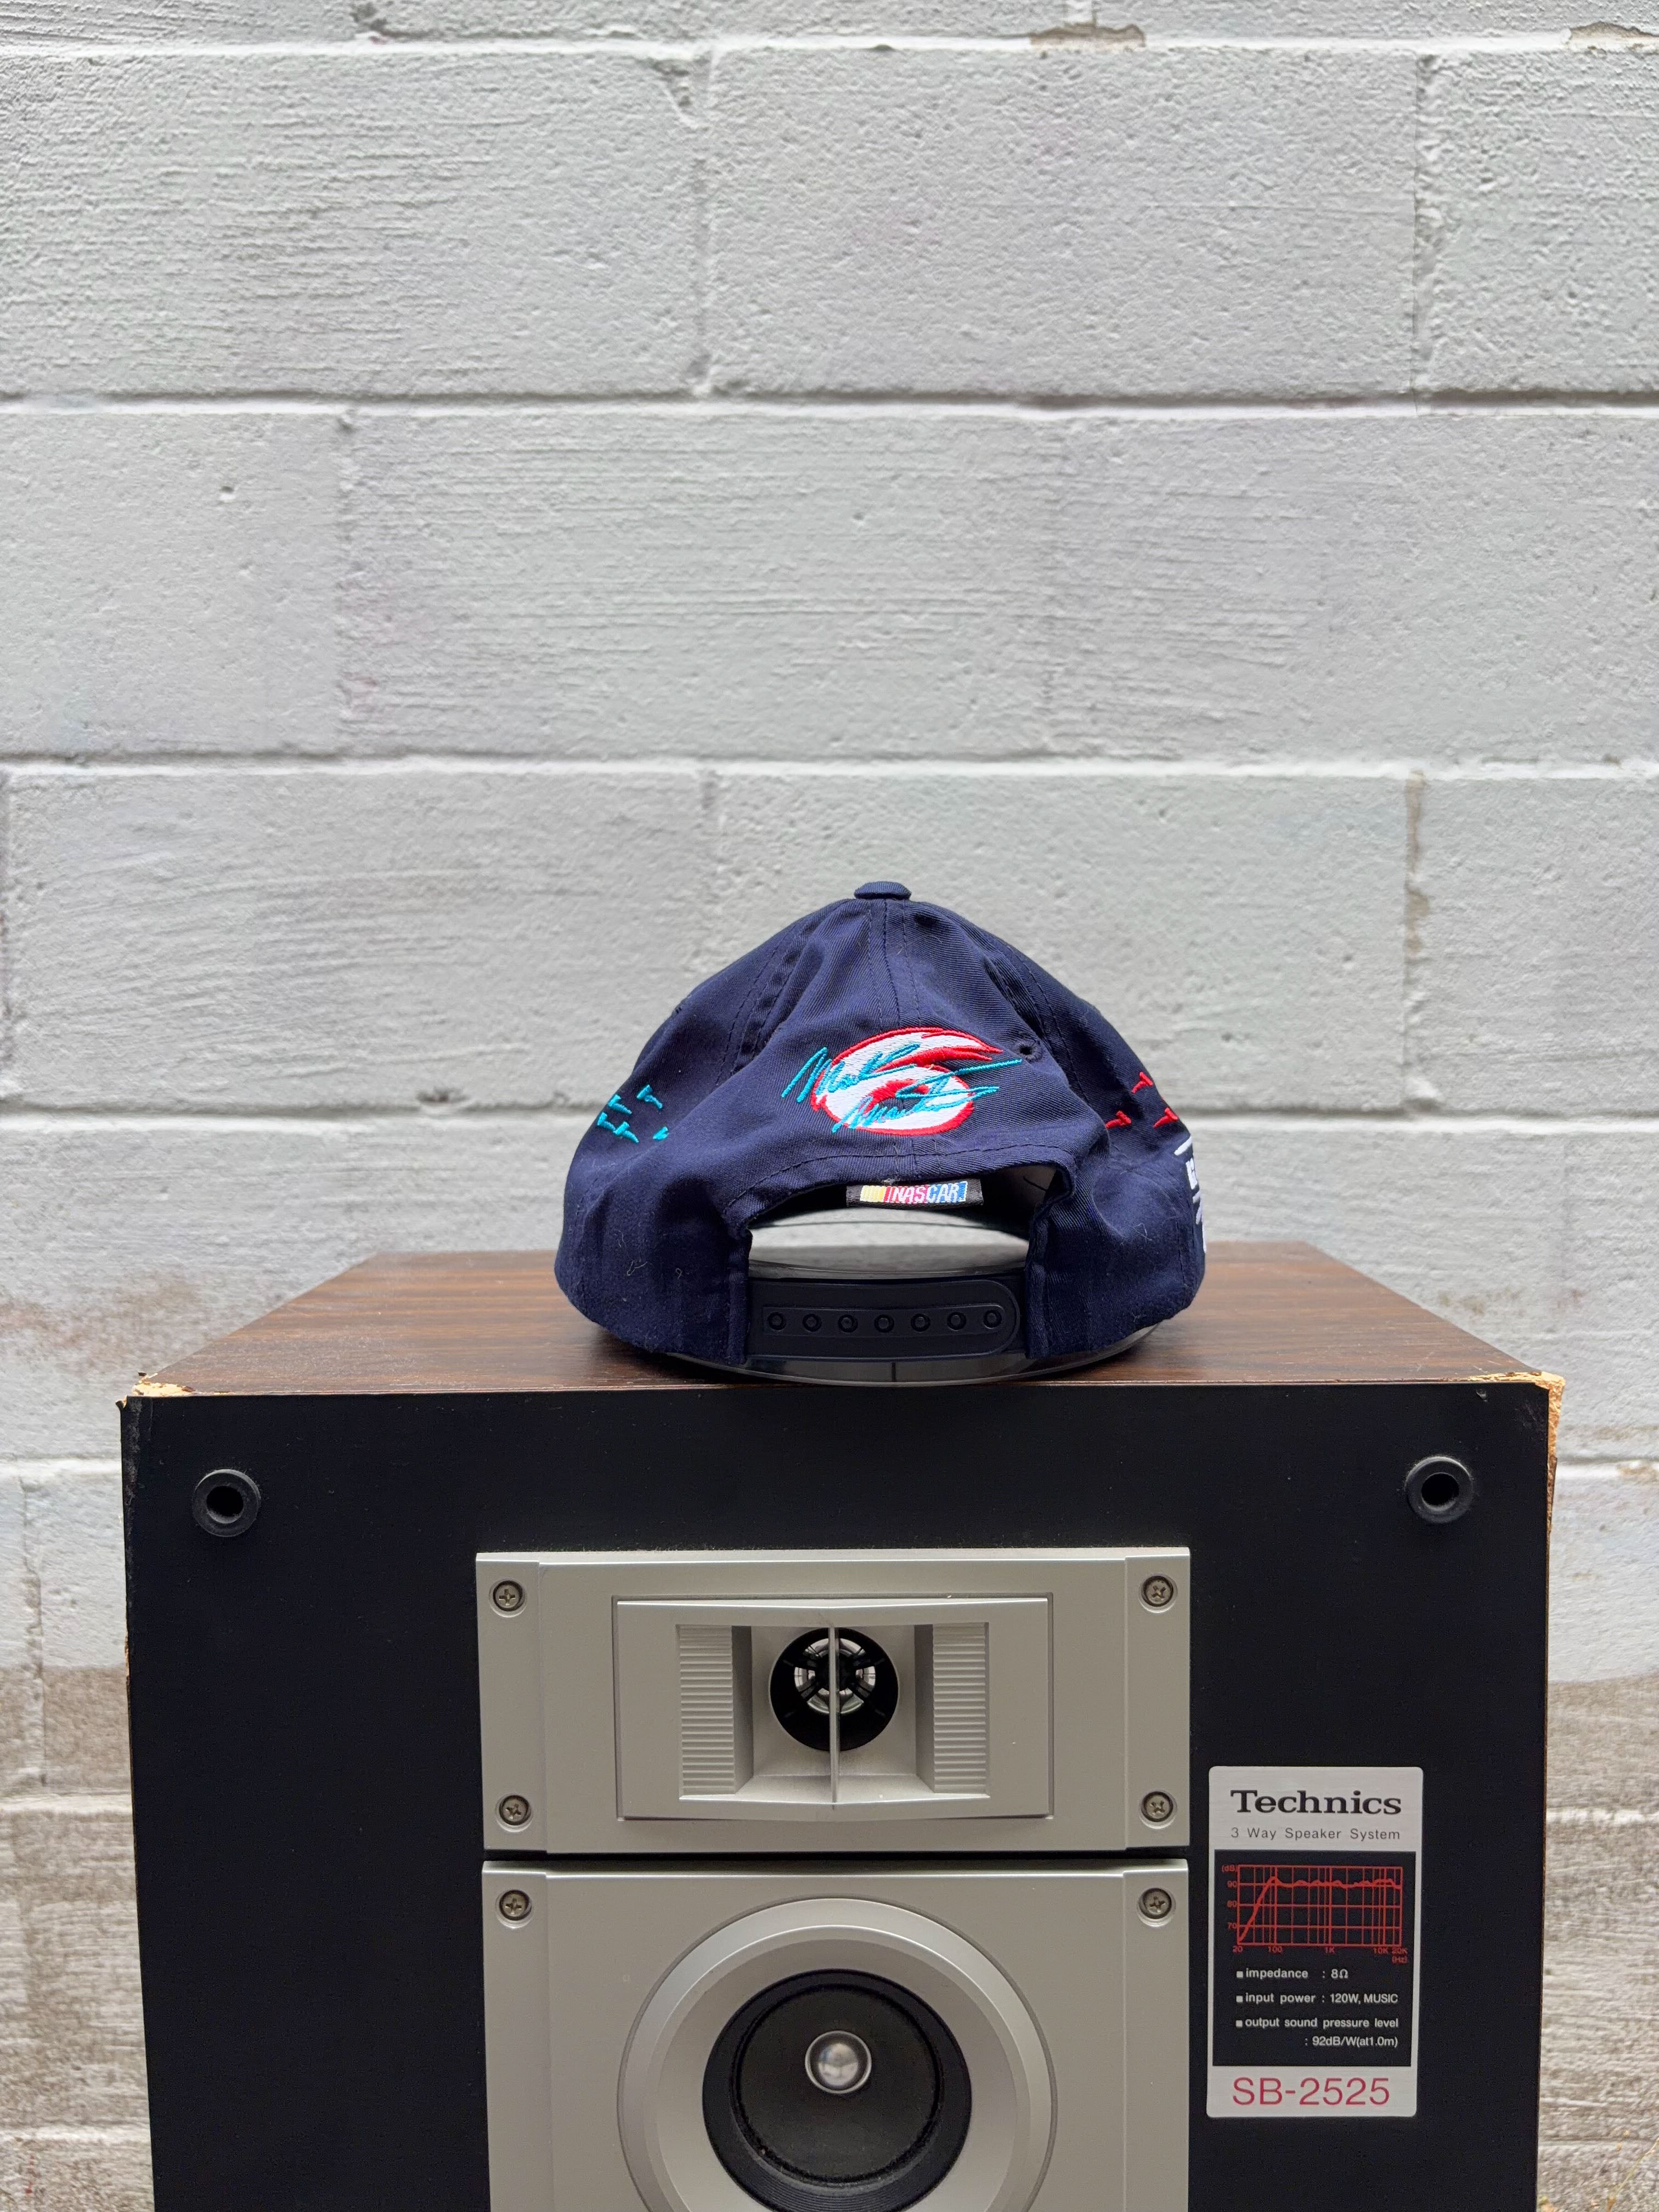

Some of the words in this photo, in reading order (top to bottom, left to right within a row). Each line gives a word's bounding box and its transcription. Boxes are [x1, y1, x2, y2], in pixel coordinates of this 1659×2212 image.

[891, 1183, 960, 1204] NASCAR
[1230, 1790, 1402, 1815] Technics
[1231, 1827, 1239, 1838] 3
[1247, 1827, 1277, 1841] Way
[1285, 1827, 1341, 1841] Speaker
[1350, 1828, 1401, 1842] System
[1246, 1968, 1308, 1979] impedance
[1245, 1992, 1274, 2005] input
[1280, 1994, 1316, 2005] power
[1330, 1993, 1361, 2005] 120W,
[1363, 1993, 1398, 2004] MUSIC
[1245, 2017, 1279, 2029] output
[1284, 2017, 1318, 2028] sound
[1323, 2019, 1370, 2029] pressure
[1374, 2017, 1398, 2028] level
[1233, 2077, 1390, 2106] SB-2525
